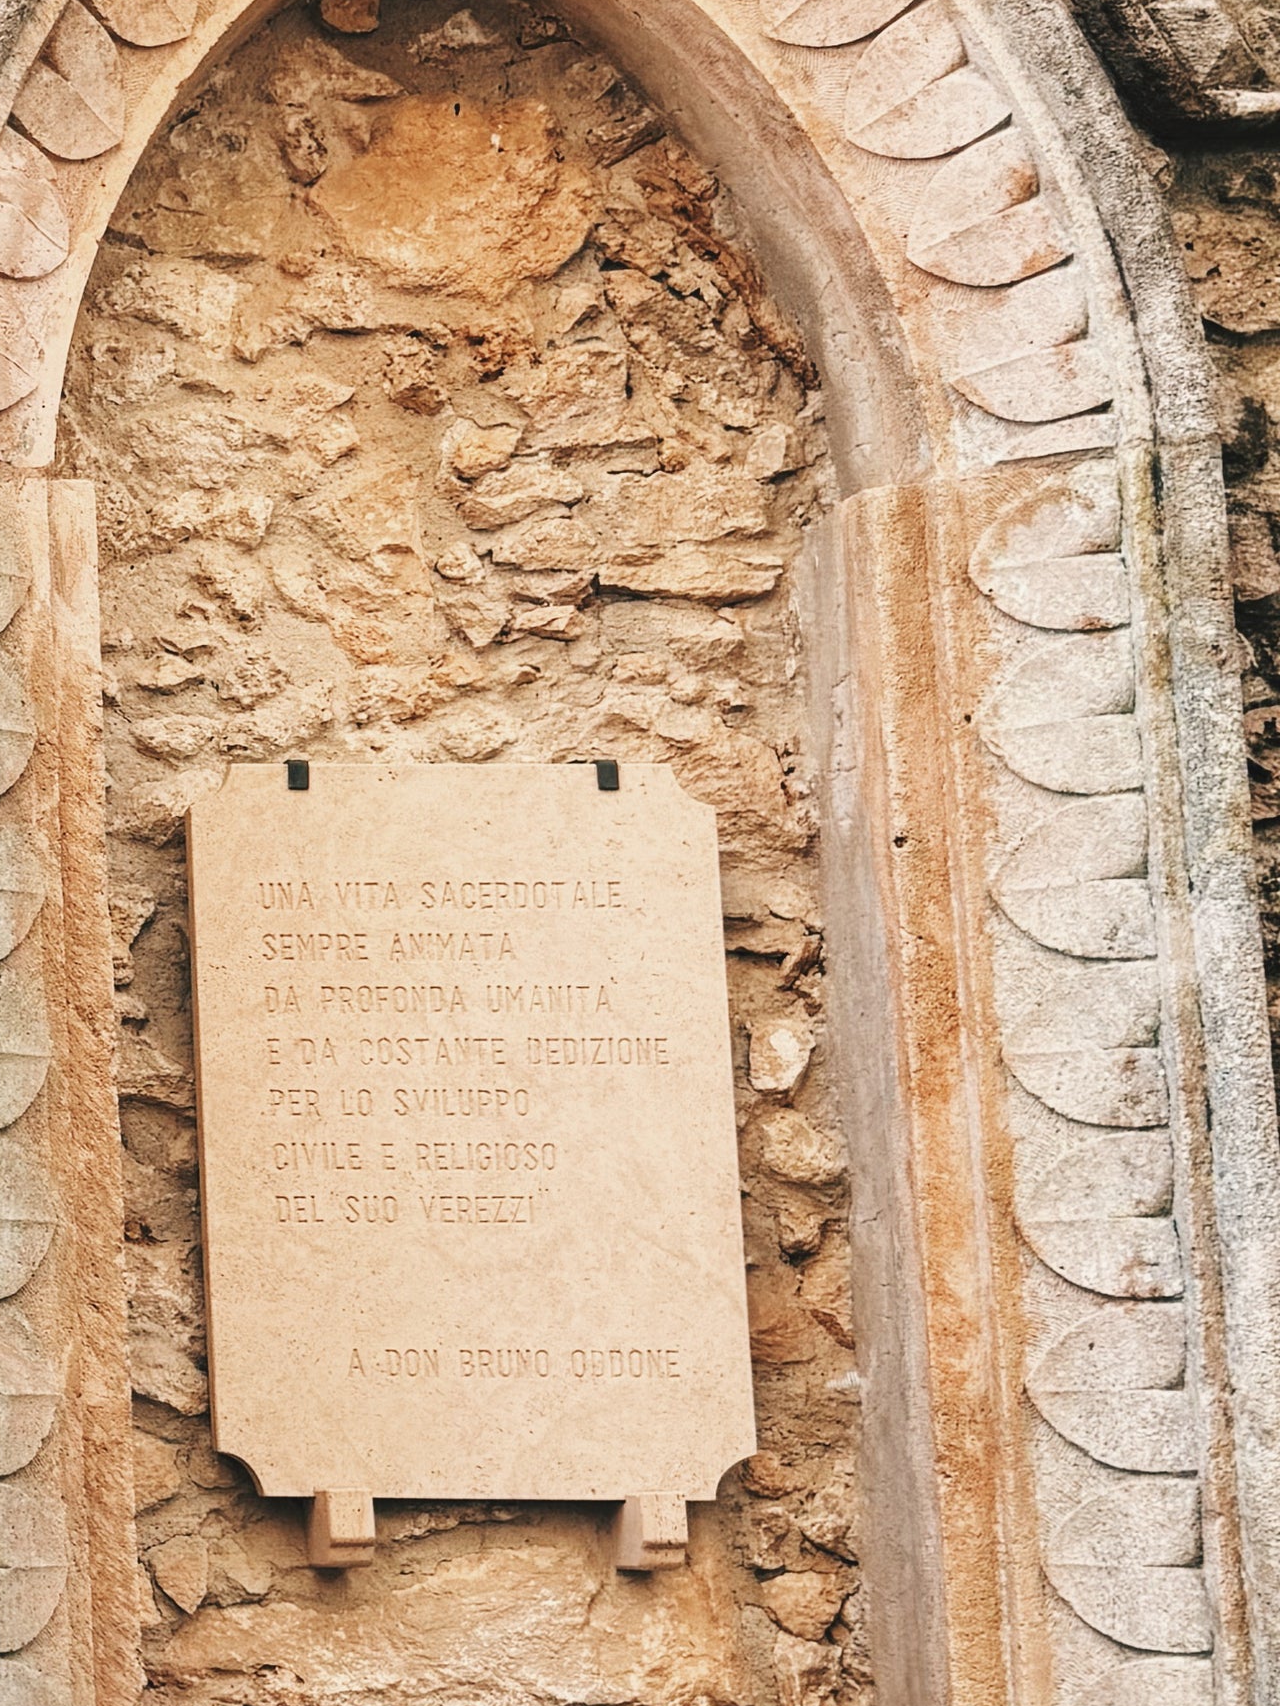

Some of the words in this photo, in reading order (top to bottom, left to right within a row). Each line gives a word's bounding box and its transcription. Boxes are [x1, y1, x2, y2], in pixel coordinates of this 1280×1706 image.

[258, 882, 315, 909] UNA
[334, 882, 399, 909] VITA
[262, 934, 368, 961] SEMPRE
[391, 934, 518, 961] ANIMATA
[264, 987, 297, 1014] DA
[322, 986, 468, 1014] PROFONDA
[268, 1039, 280, 1065] E
[301, 1039, 338, 1065] DA
[359, 1039, 505, 1065] COSTANTE
[527, 1038, 669, 1065] DEDIZIONE
[270, 1091, 319, 1117] PER
[342, 1090, 374, 1117] LO
[394, 1090, 529, 1117] SVILUPPO
[272, 1144, 361, 1171] CIVILE
[382, 1144, 393, 1170] E
[416, 1144, 558, 1171] RELIGIOSO
[276, 1196, 323, 1223] DEL
[345, 1195, 398, 1223] SUO
[422, 1196, 536, 1223] VEREZZI
[349, 1349, 366, 1376] A
[386, 1349, 438, 1377] DON
[459, 1349, 549, 1377] BRUNO
